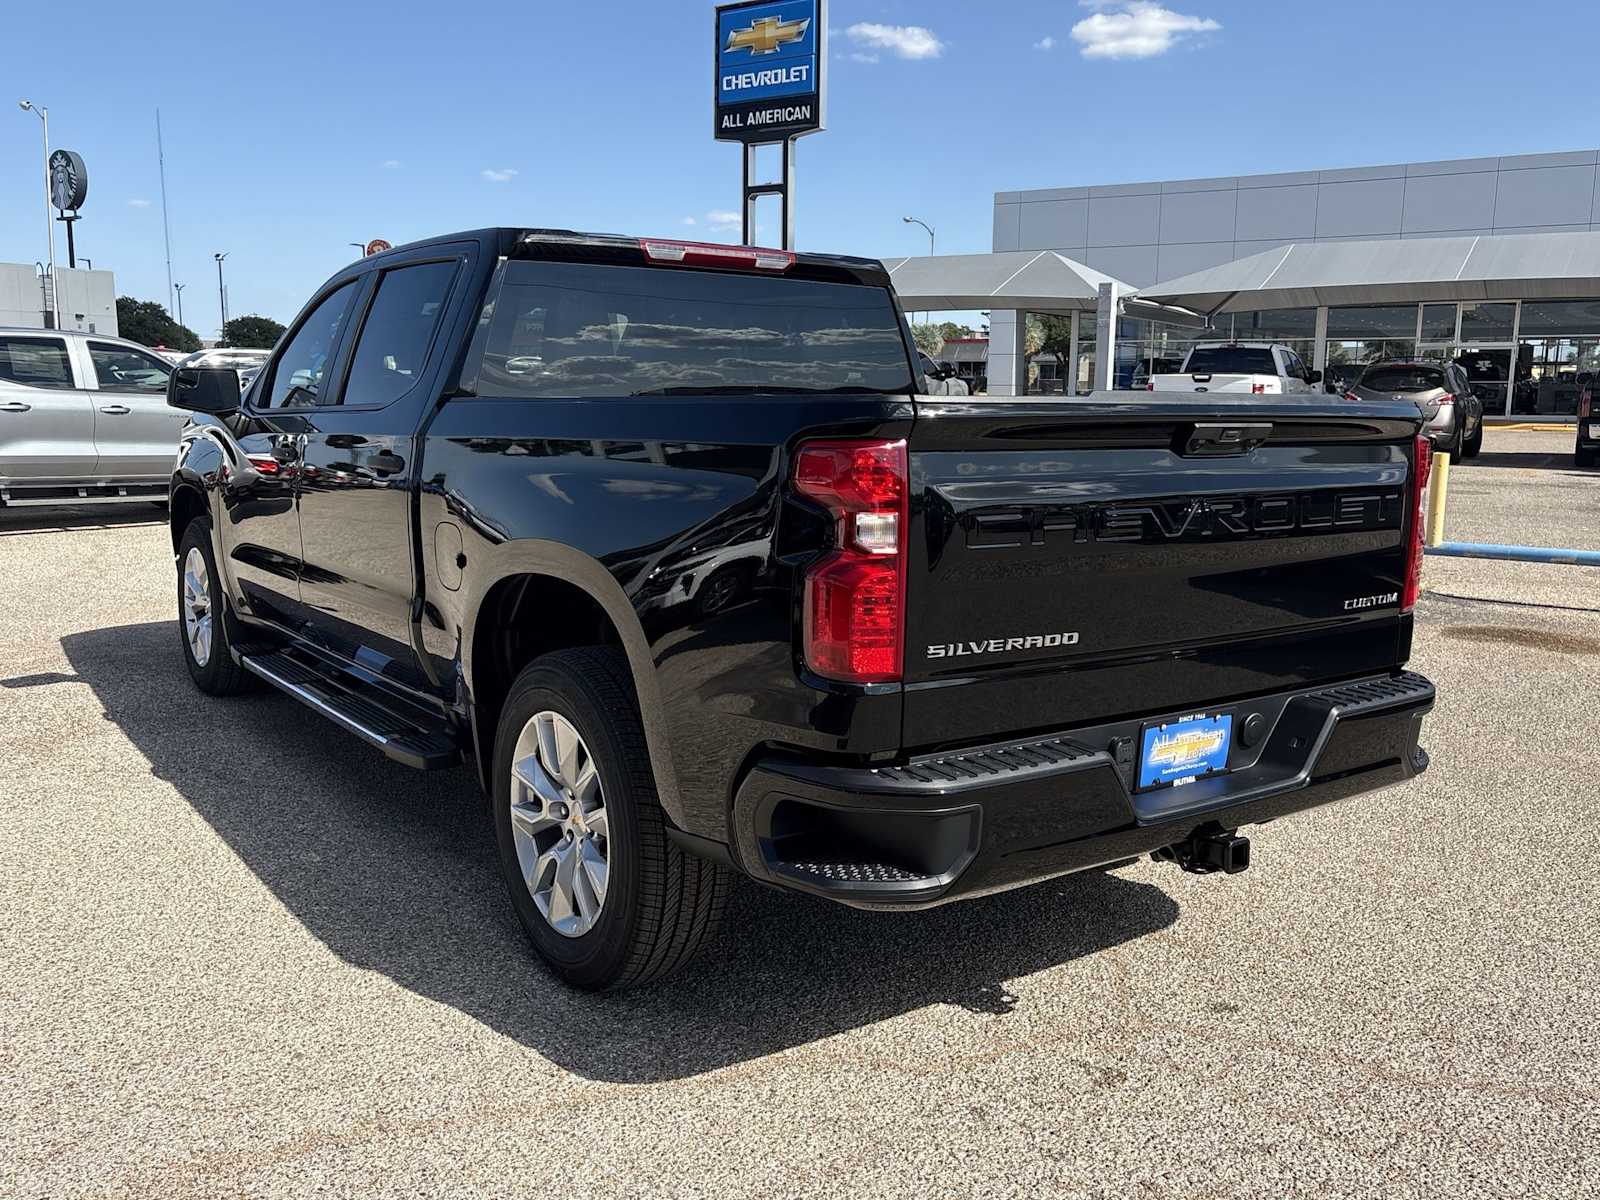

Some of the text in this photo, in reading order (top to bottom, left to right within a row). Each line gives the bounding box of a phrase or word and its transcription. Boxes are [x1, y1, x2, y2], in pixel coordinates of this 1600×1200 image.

[722, 65, 809, 91] CHEVROLET
[722, 105, 811, 129] ALL AMERICAN
[966, 494, 1399, 550] CHEVROLET
[1344, 592, 1398, 610] CUSTOM
[927, 632, 1079, 659] SILVERADO
